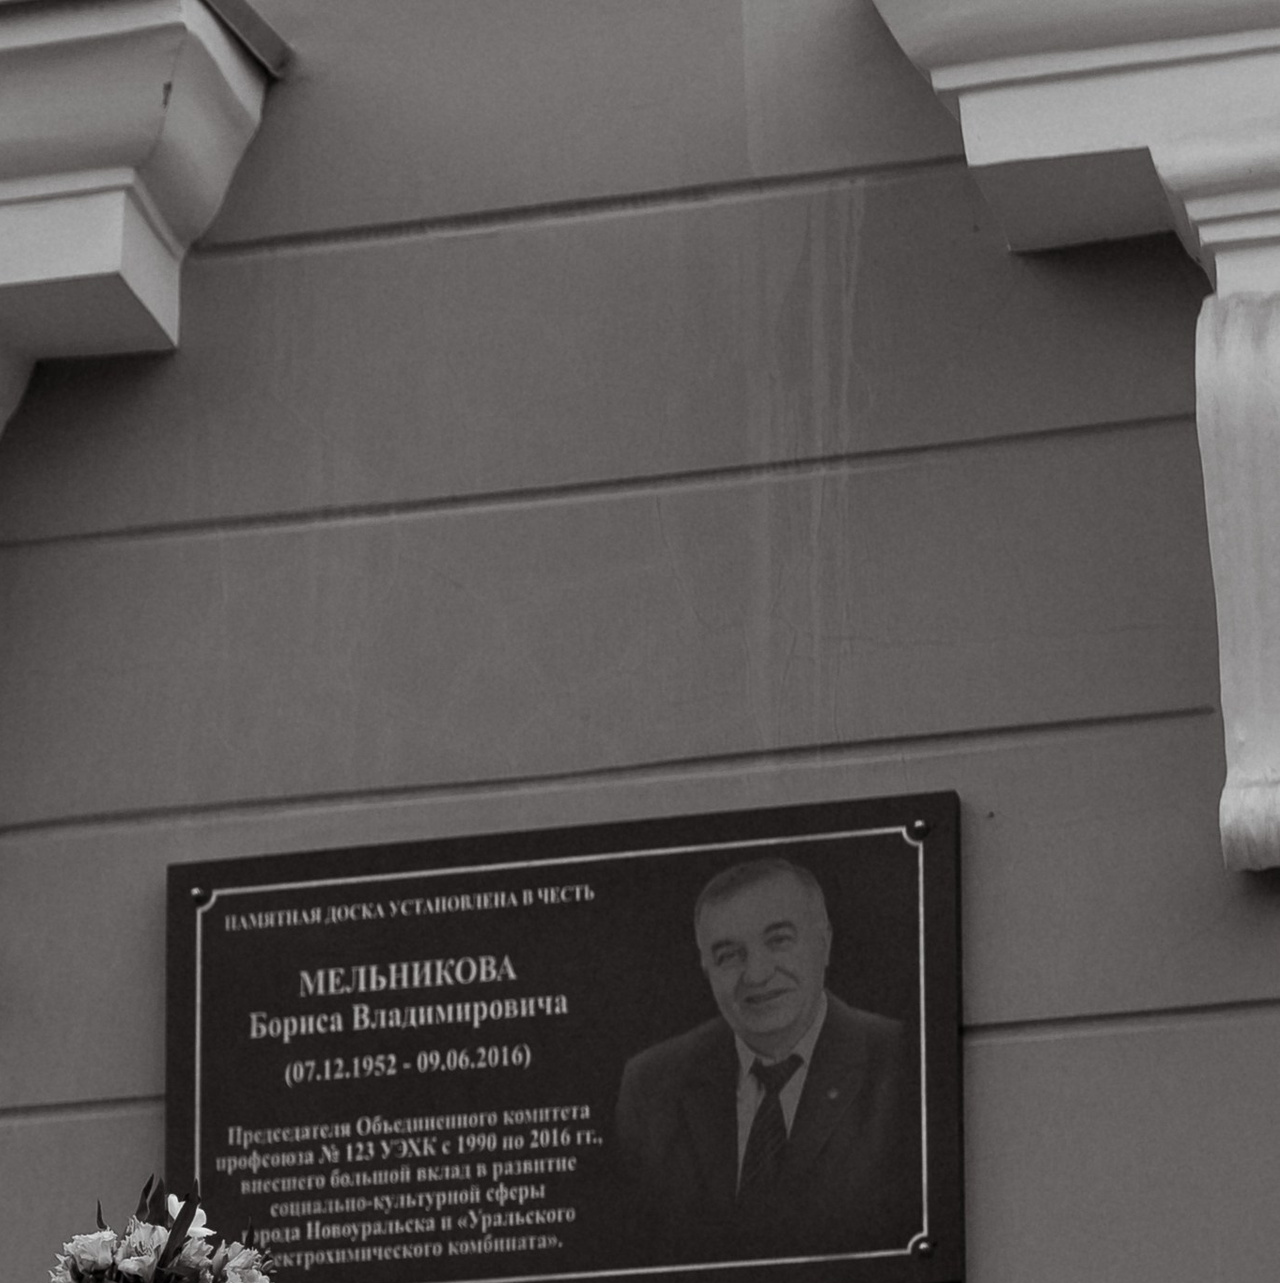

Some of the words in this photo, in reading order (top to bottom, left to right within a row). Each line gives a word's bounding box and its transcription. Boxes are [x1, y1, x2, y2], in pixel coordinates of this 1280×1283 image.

[224, 907, 321, 931] ПАМЯТНАЯ
[324, 902, 385, 925] ДОСКА
[389, 891, 518, 918] УСТАНОВЛЕНА
[522, 889, 533, 906] В
[537, 884, 595, 905] ЧЕСТЬ
[299, 955, 517, 998] МЕЛЬНИКОВА
[250, 1011, 343, 1044] Бориса
[352, 994, 568, 1031] Владимировича
[285, 1053, 397, 1088] (07.12.1952
[416, 1042, 532, 1073] 09.06.2016)
[227, 1122, 351, 1150] Председателя
[355, 1110, 498, 1137] Объединенного
[503, 1104, 591, 1126] комитета
[215, 1149, 314, 1176] профсоюза
[318, 1143, 341, 1165] №
[346, 1141, 375, 1162] 123
[380, 1136, 438, 1160] УЭХК
[441, 1140, 451, 1155] с
[458, 1132, 498, 1154] 1990
[502, 1134, 524, 1151] по
[530, 1127, 570, 1149] 2016
[240, 1173, 326, 1195] внесшего
[330, 1163, 412, 1189] большой
[416, 1163, 472, 1182] вклад
[476, 1162, 487, 1178] в
[492, 1155, 578, 1181] развитие
[270, 1184, 482, 1218] социально-культурной
[486, 1182, 546, 1207] сферы
[306, 1216, 437, 1242] Новоуральска
[441, 1216, 452, 1231] и
[457, 1207, 577, 1234] «Уральского
[448, 1233, 564, 1256] комбината».
